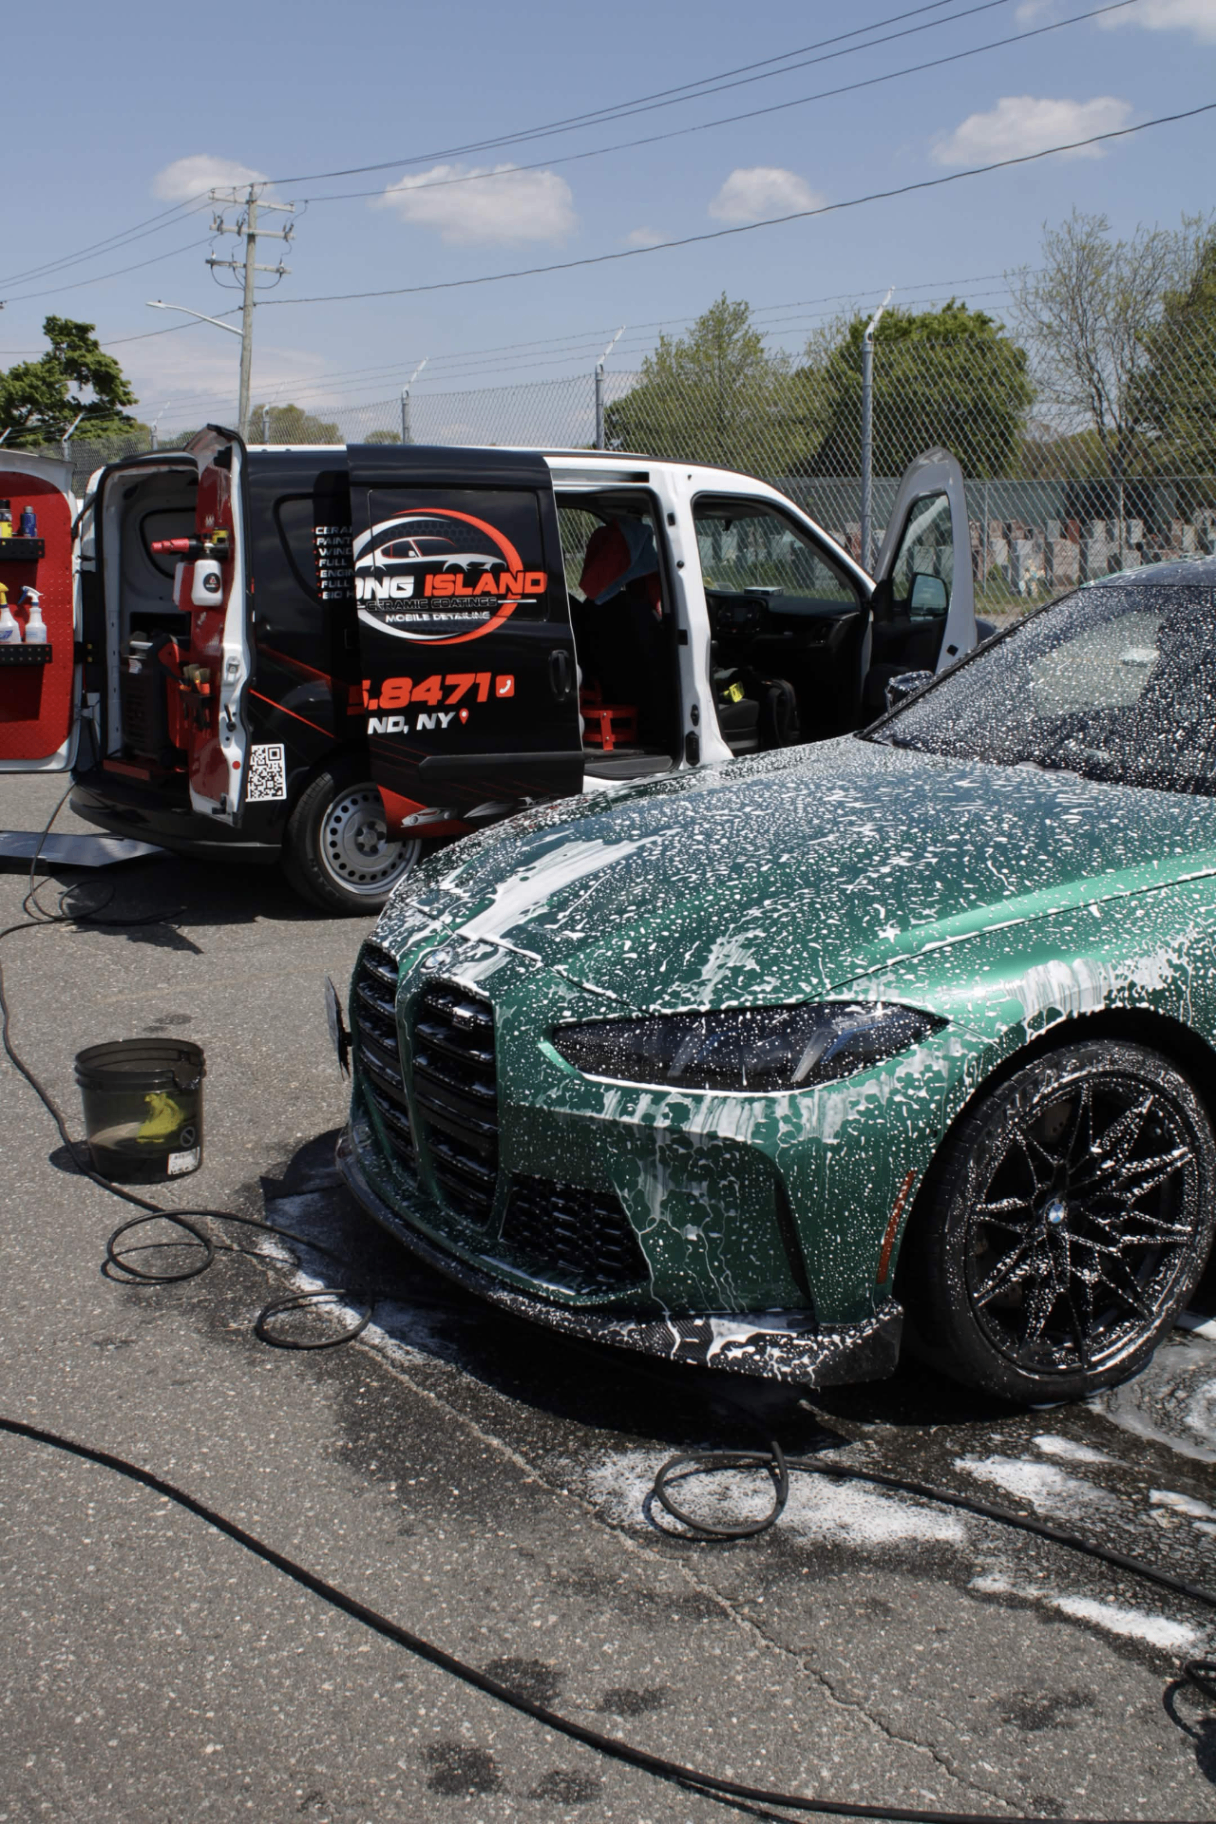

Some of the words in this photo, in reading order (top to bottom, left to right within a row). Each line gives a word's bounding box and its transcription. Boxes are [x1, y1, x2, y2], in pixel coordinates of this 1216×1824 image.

[315, 526, 352, 535] CERA
[319, 558, 347, 567] FULL
[321, 579, 350, 589] FULL
[424, 571, 548, 597] ISLAND
[366, 599, 429, 612] CERAMIC
[431, 596, 498, 609] COATINGS
[385, 612, 430, 623] MOBILE
[433, 610, 491, 621] DETAILING
[362, 672, 492, 710] .8471
[416, 711, 456, 730] NY
